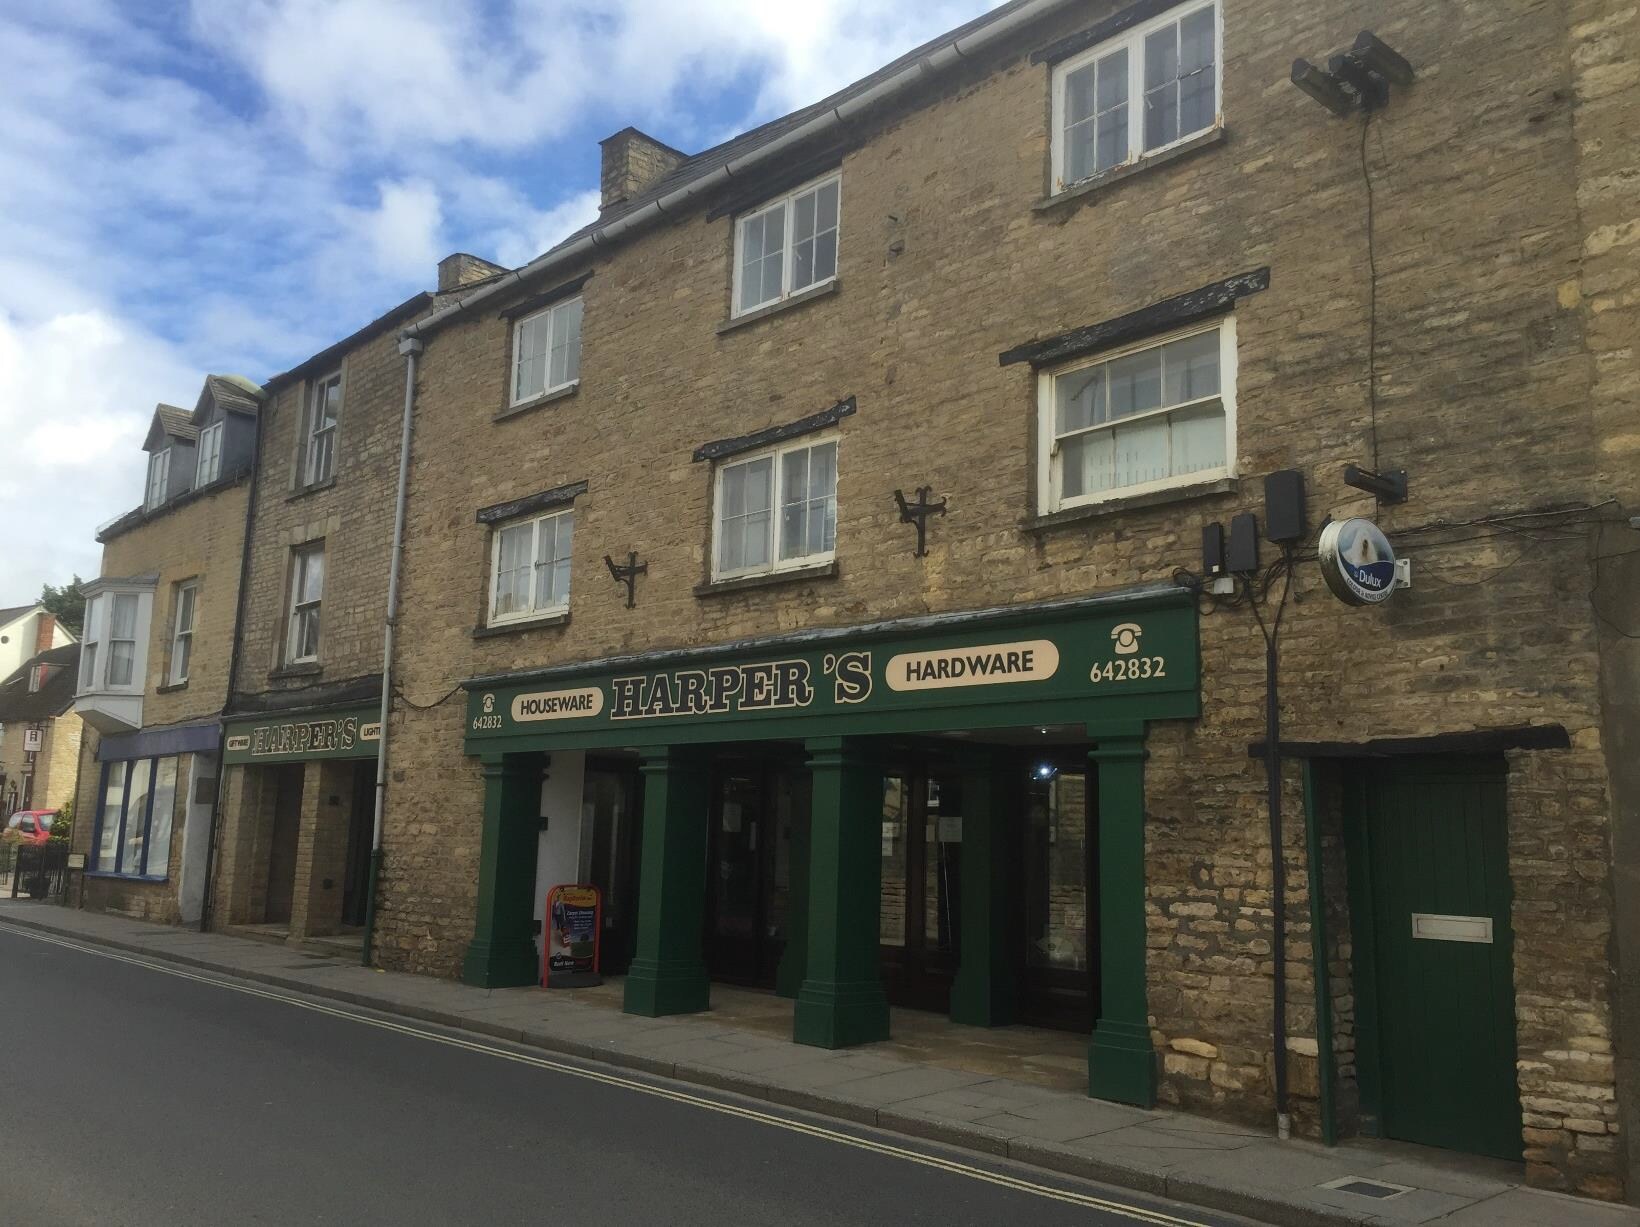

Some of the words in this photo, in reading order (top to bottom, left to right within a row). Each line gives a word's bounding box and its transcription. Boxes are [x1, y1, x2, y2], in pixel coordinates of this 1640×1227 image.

[1360, 569, 1381, 588] Dulux
[906, 650, 1034, 682] HARDWARE
[1090, 656, 1166, 683] 642832
[610, 652, 872, 720] HARPER'S
[520, 693, 593, 716] HOUSEWARE
[252, 717, 358, 755] HARPER'S
[472, 715, 502, 730] 642832
